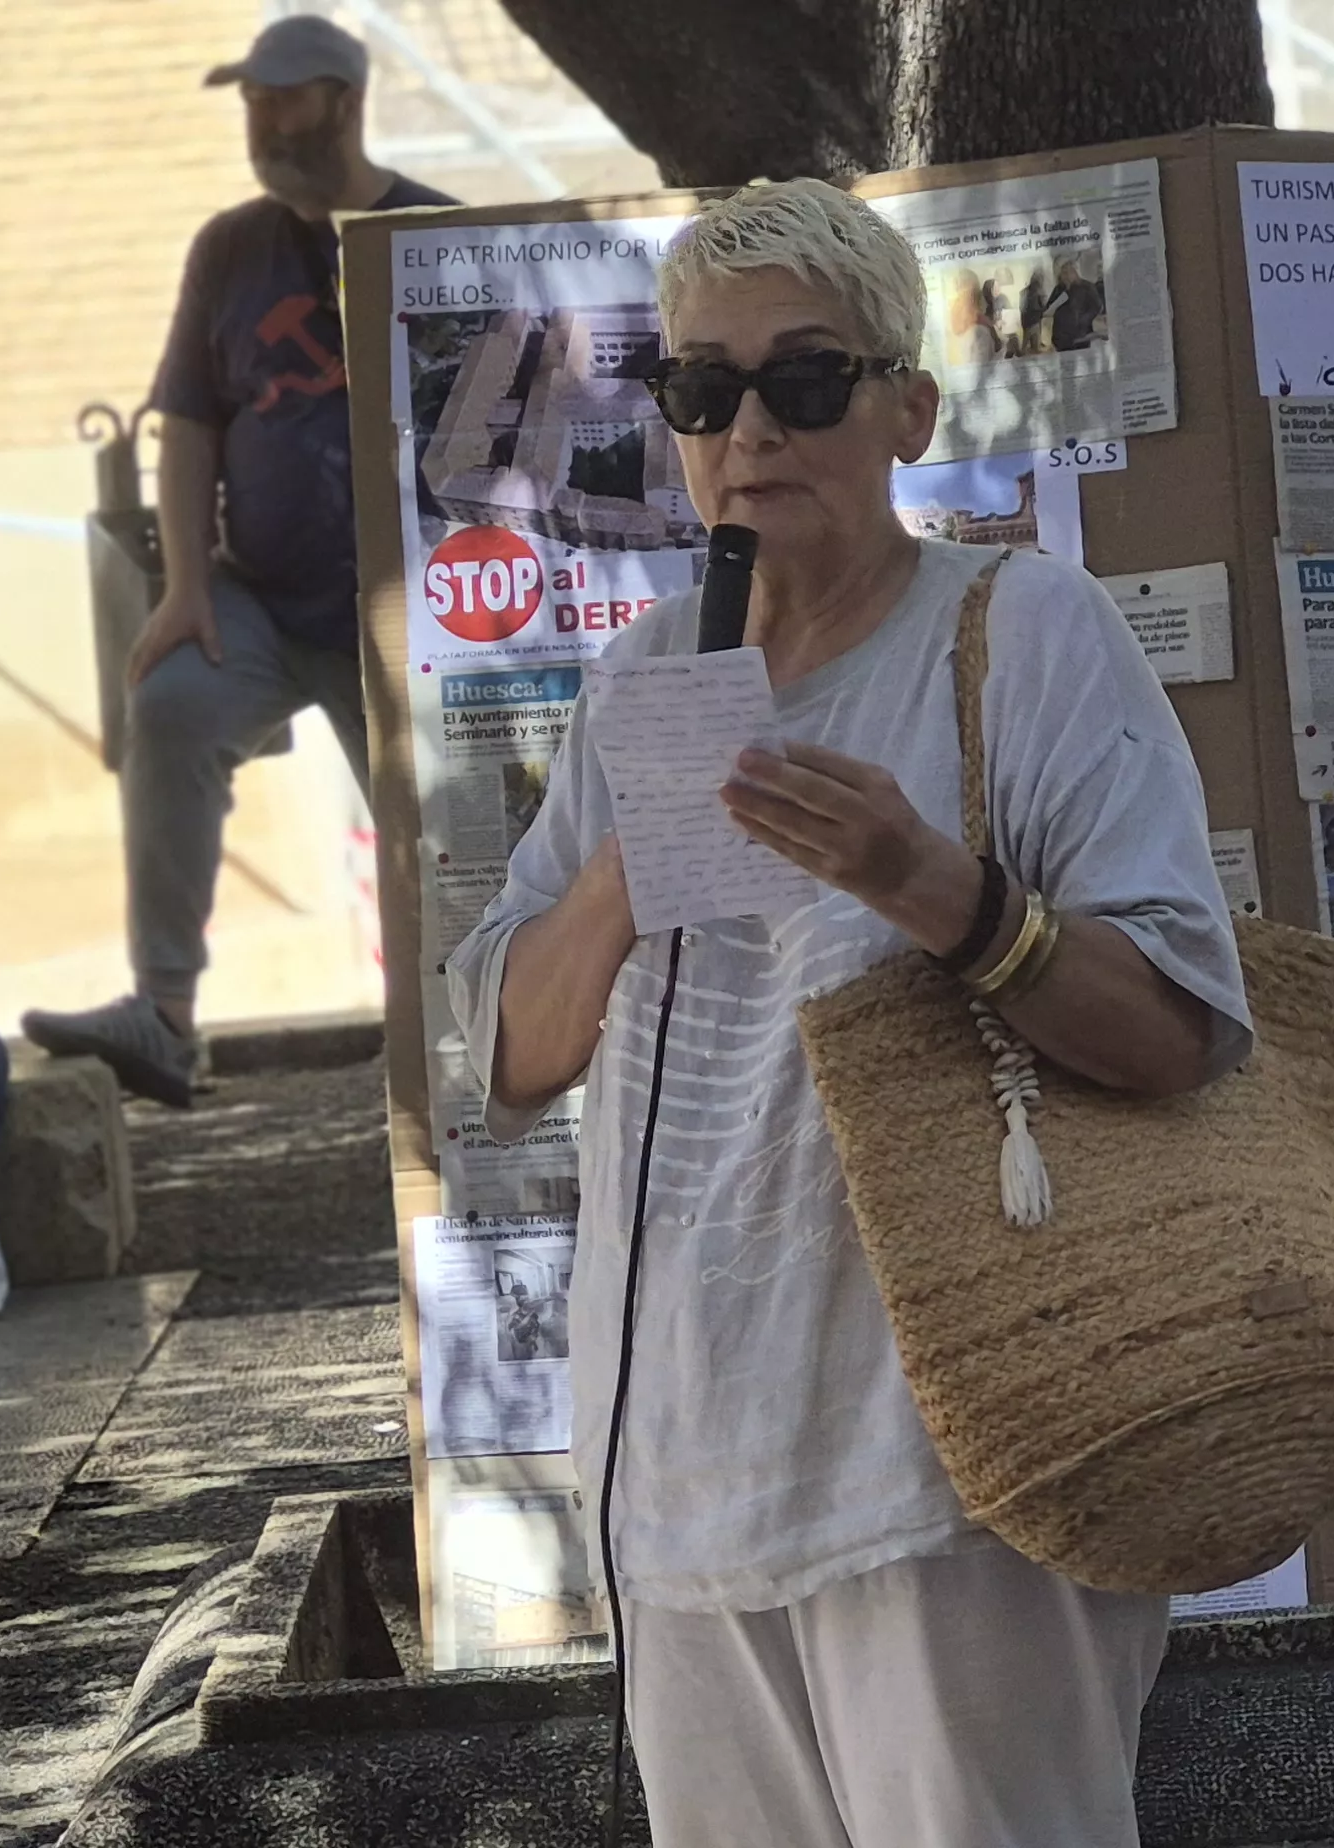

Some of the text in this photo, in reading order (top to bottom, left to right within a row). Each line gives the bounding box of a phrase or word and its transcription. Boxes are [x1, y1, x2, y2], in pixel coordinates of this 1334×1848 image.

[963, 217, 1089, 243] en Huesca la falta de
[1255, 223, 1289, 243] UN
[404, 248, 429, 268] EL
[436, 240, 591, 266] PATRIMONIO
[600, 238, 647, 258] POR
[958, 243, 1016, 259] conservar
[1021, 239, 1032, 250] el
[1035, 232, 1101, 249] patrimonio
[1259, 262, 1305, 283] DOS
[404, 284, 514, 307] SUELOS...
[1279, 417, 1290, 430] la
[1292, 417, 1317, 430] lista
[1049, 443, 1117, 468] S.O.S
[427, 558, 584, 616] STOP al
[505, 648, 519, 656] EN
[523, 643, 575, 654] DEFENSA
[577, 641, 598, 651] DEL
[446, 681, 543, 702] Huesca:
[443, 706, 561, 726] El Ayuntamiento
[444, 724, 547, 742] Seminario y se
[463, 1129, 572, 1150] el cuartel
